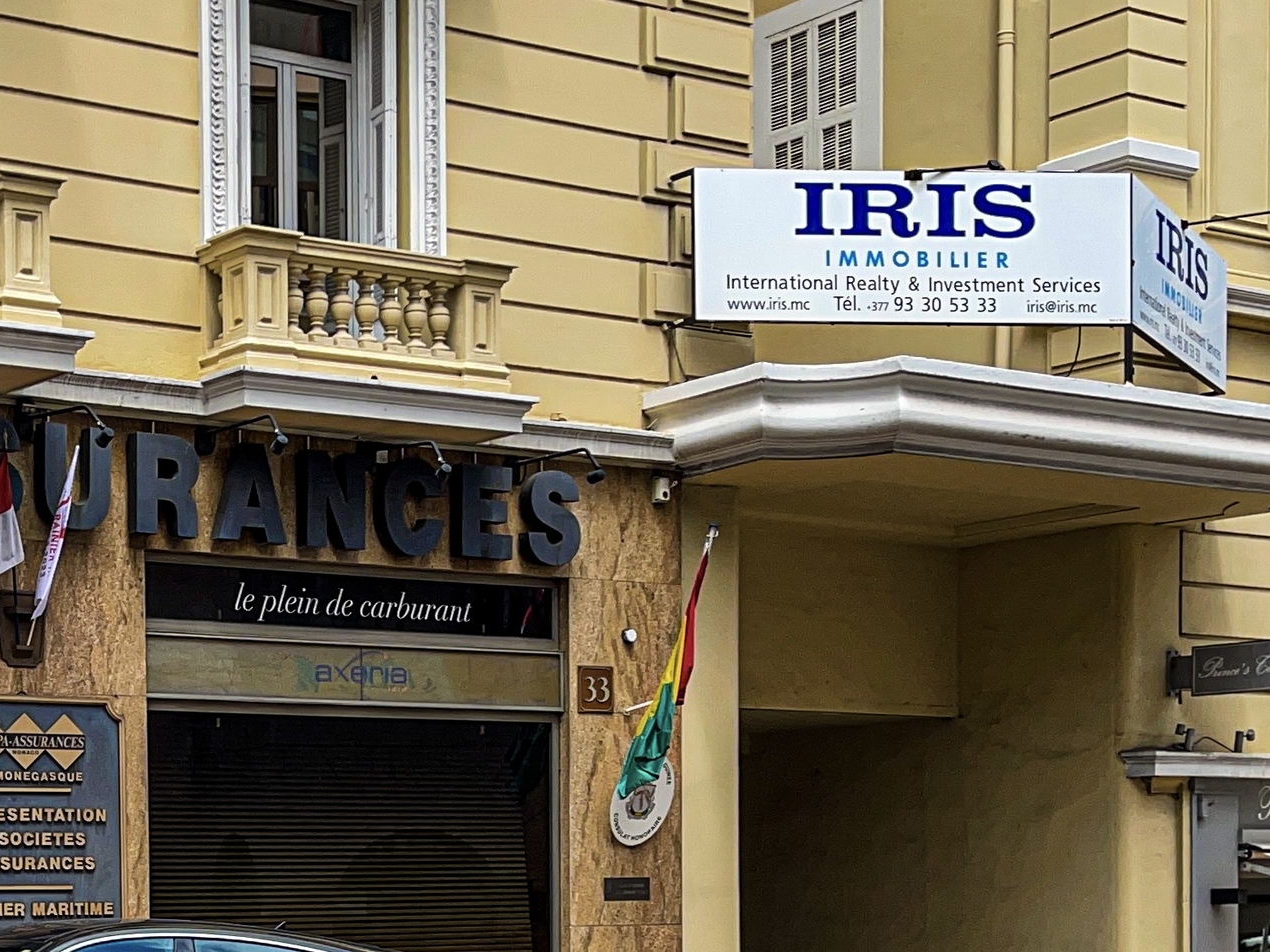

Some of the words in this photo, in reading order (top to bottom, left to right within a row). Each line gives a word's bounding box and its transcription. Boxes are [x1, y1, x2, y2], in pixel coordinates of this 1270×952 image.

[795, 182, 1036, 239] IRIS
[825, 249, 1009, 269] IMMOBILIER
[1155, 209, 1209, 300] IRIS
[726, 274, 838, 291] International
[846, 275, 900, 294] Realty
[909, 277, 920, 292] &
[929, 277, 1024, 293] Investment
[1032, 277, 1101, 294] Services
[727, 298, 811, 312] www.iris.mc
[833, 294, 861, 312] Tél.
[894, 297, 914, 313] 93
[921, 297, 942, 313] 30
[949, 297, 969, 313] 53
[978, 297, 997, 314] 33
[1026, 299, 1098, 315] iris@iris.mc
[234, 582, 256, 612] le
[258, 584, 320, 622] plein
[326, 588, 354, 616] de
[359, 593, 472, 623] carburant
[315, 663, 408, 685] axeria
[584, 676, 610, 703] 33
[32, 902, 114, 917] MARITIME
